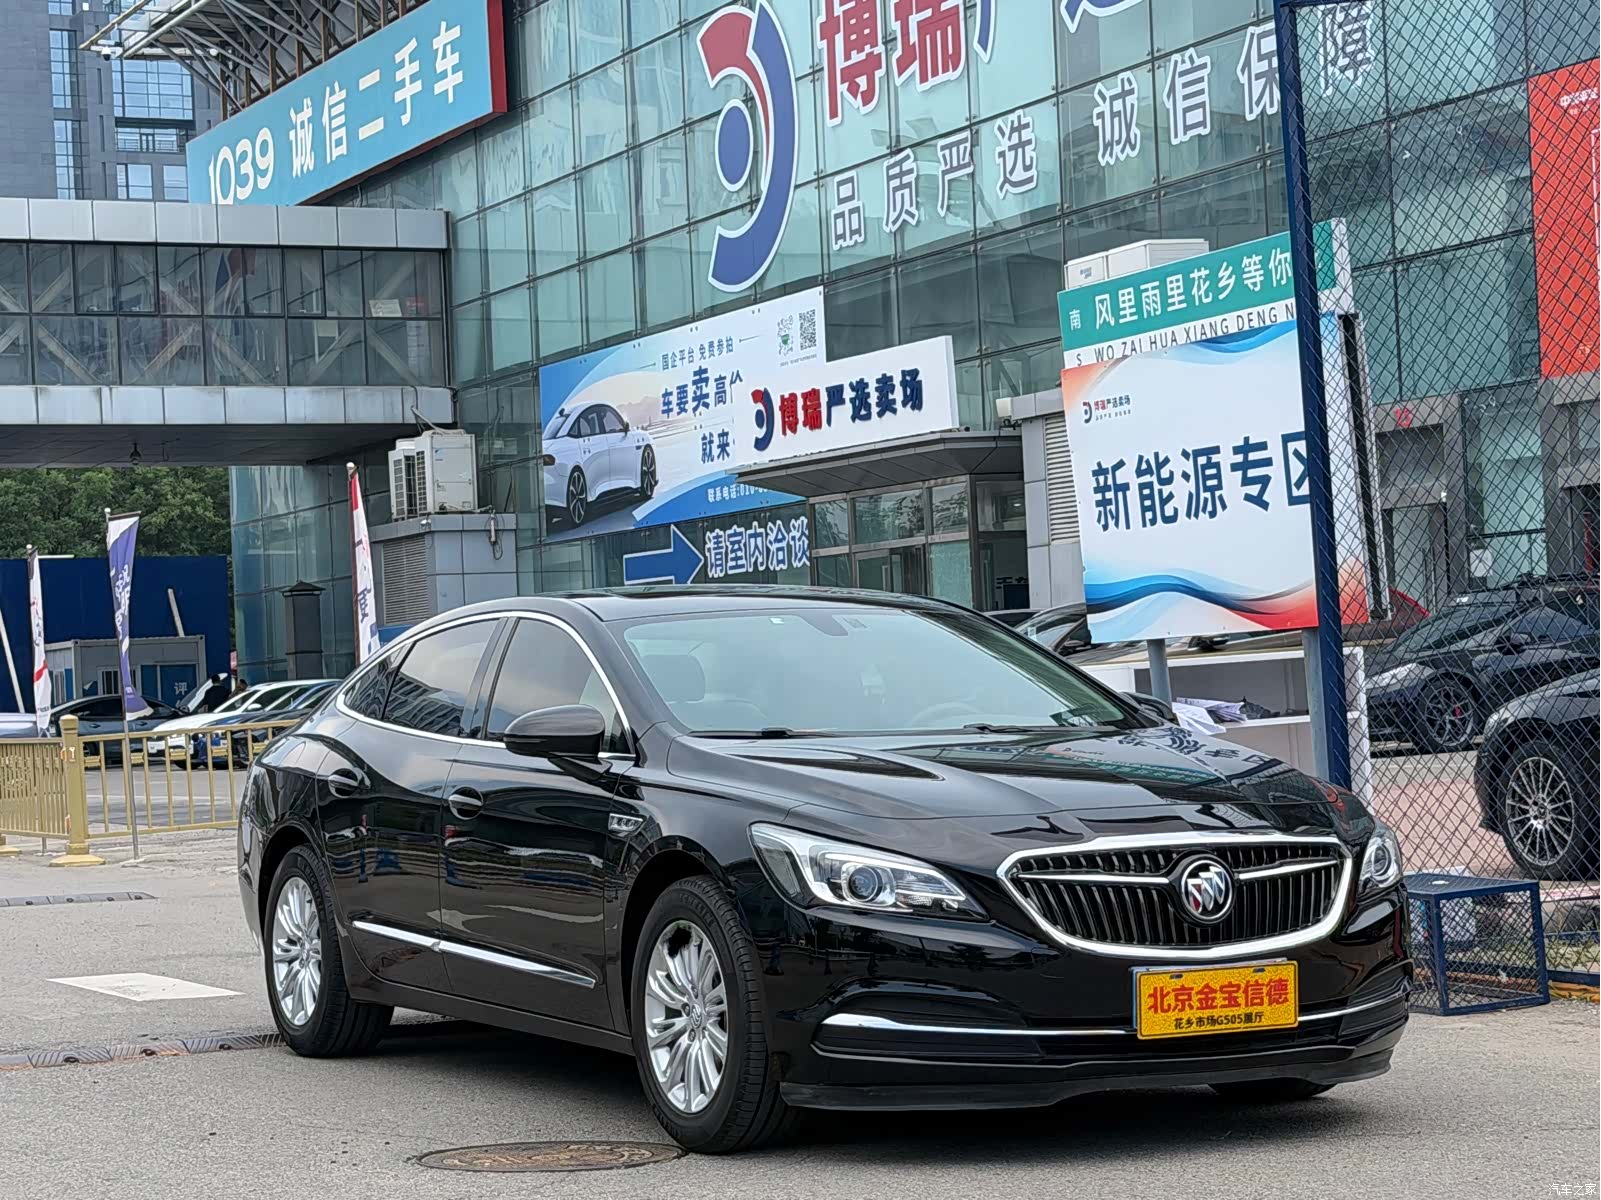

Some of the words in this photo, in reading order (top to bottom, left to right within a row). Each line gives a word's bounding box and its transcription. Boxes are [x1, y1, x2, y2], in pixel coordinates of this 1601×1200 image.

[208, 127, 274, 205] 1039
[288, 20, 464, 178] 诚信二手车
[832, 109, 1037, 250] 品质严选
[1069, 308, 1082, 331] 南
[1094, 247, 1292, 330] 风里雨里花乡等你
[661, 346, 695, 371] 国企平台
[699, 336, 734, 361] 免费参拍
[1076, 353, 1083, 366] S
[1094, 345, 1115, 363] WO
[1121, 338, 1143, 358] ZAI
[1150, 330, 1179, 351] HUA
[1184, 318, 1230, 344] XIANG
[1236, 307, 1278, 332] DENG
[779, 368, 923, 436] 博瑞严选卖场
[1092, 430, 1310, 532] 新能源专区
[705, 516, 810, 578] 请室内洽谈
[1148, 977, 1290, 1014] 北京金宝信德
[1174, 1011, 1265, 1030] 花乡市场G505展厅
